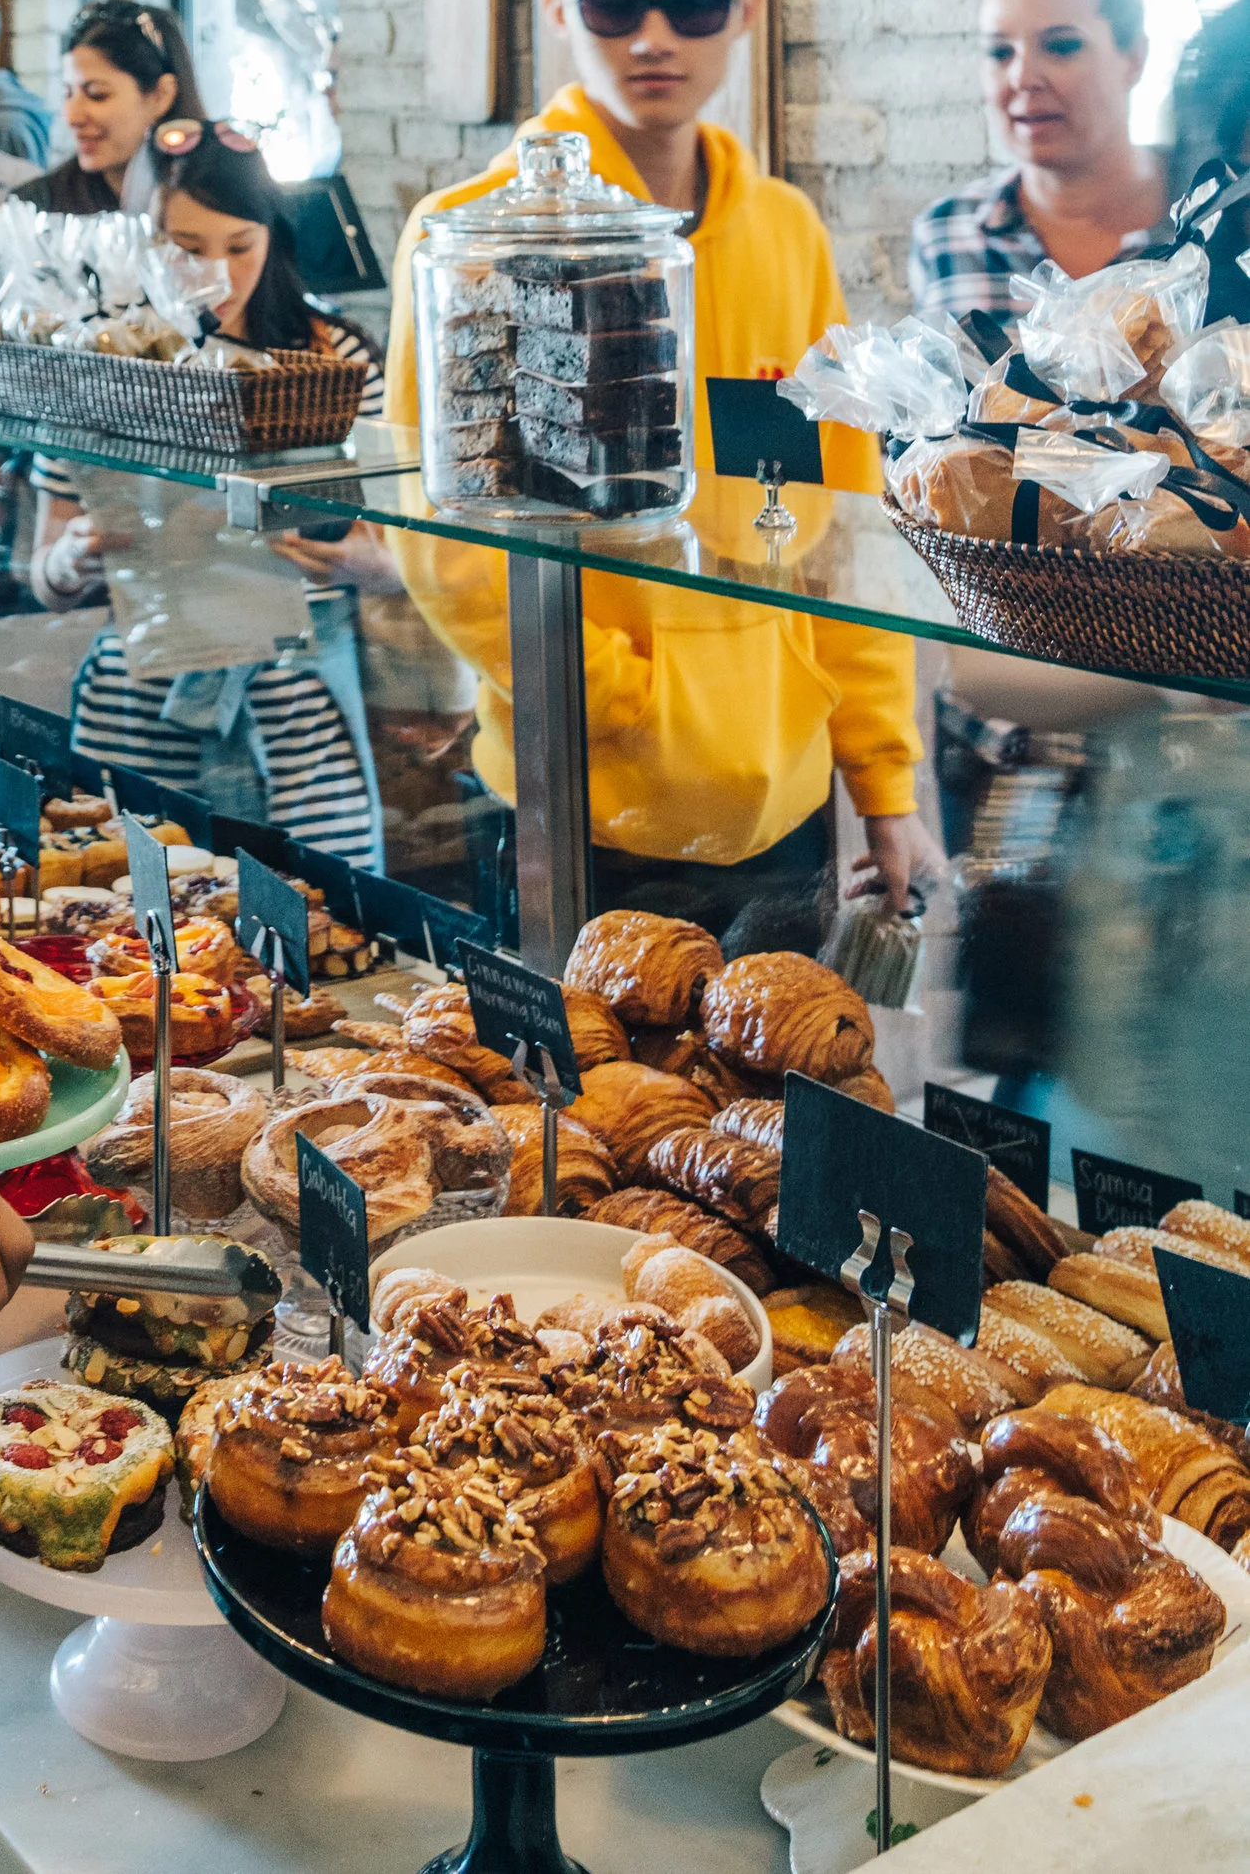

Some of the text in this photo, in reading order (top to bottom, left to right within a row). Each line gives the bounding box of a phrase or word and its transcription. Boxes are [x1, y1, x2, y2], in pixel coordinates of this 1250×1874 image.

[466, 953, 548, 1006] Cinnamon
[471, 982, 563, 1035] Morning Bun
[1078, 1157, 1154, 1206] Samoa
